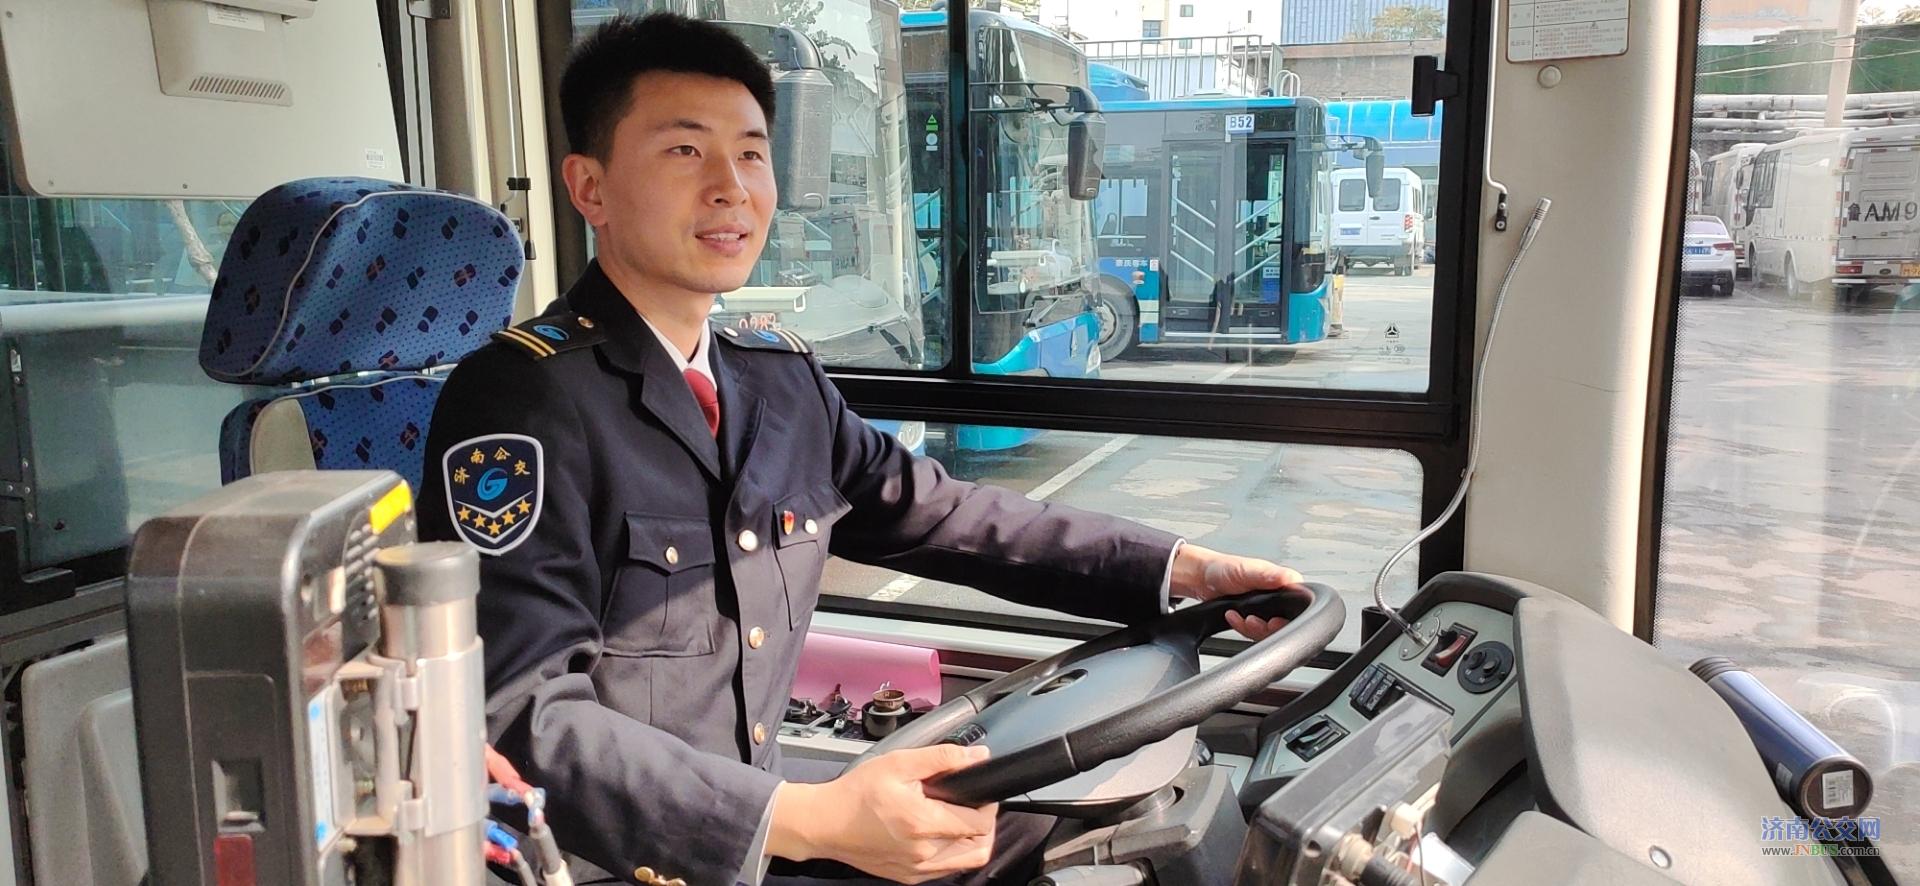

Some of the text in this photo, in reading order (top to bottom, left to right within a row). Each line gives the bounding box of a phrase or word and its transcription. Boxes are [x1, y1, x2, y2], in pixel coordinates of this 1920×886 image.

[1229, 115, 1253, 129] B52
[454, 446, 531, 485] 济南公交
